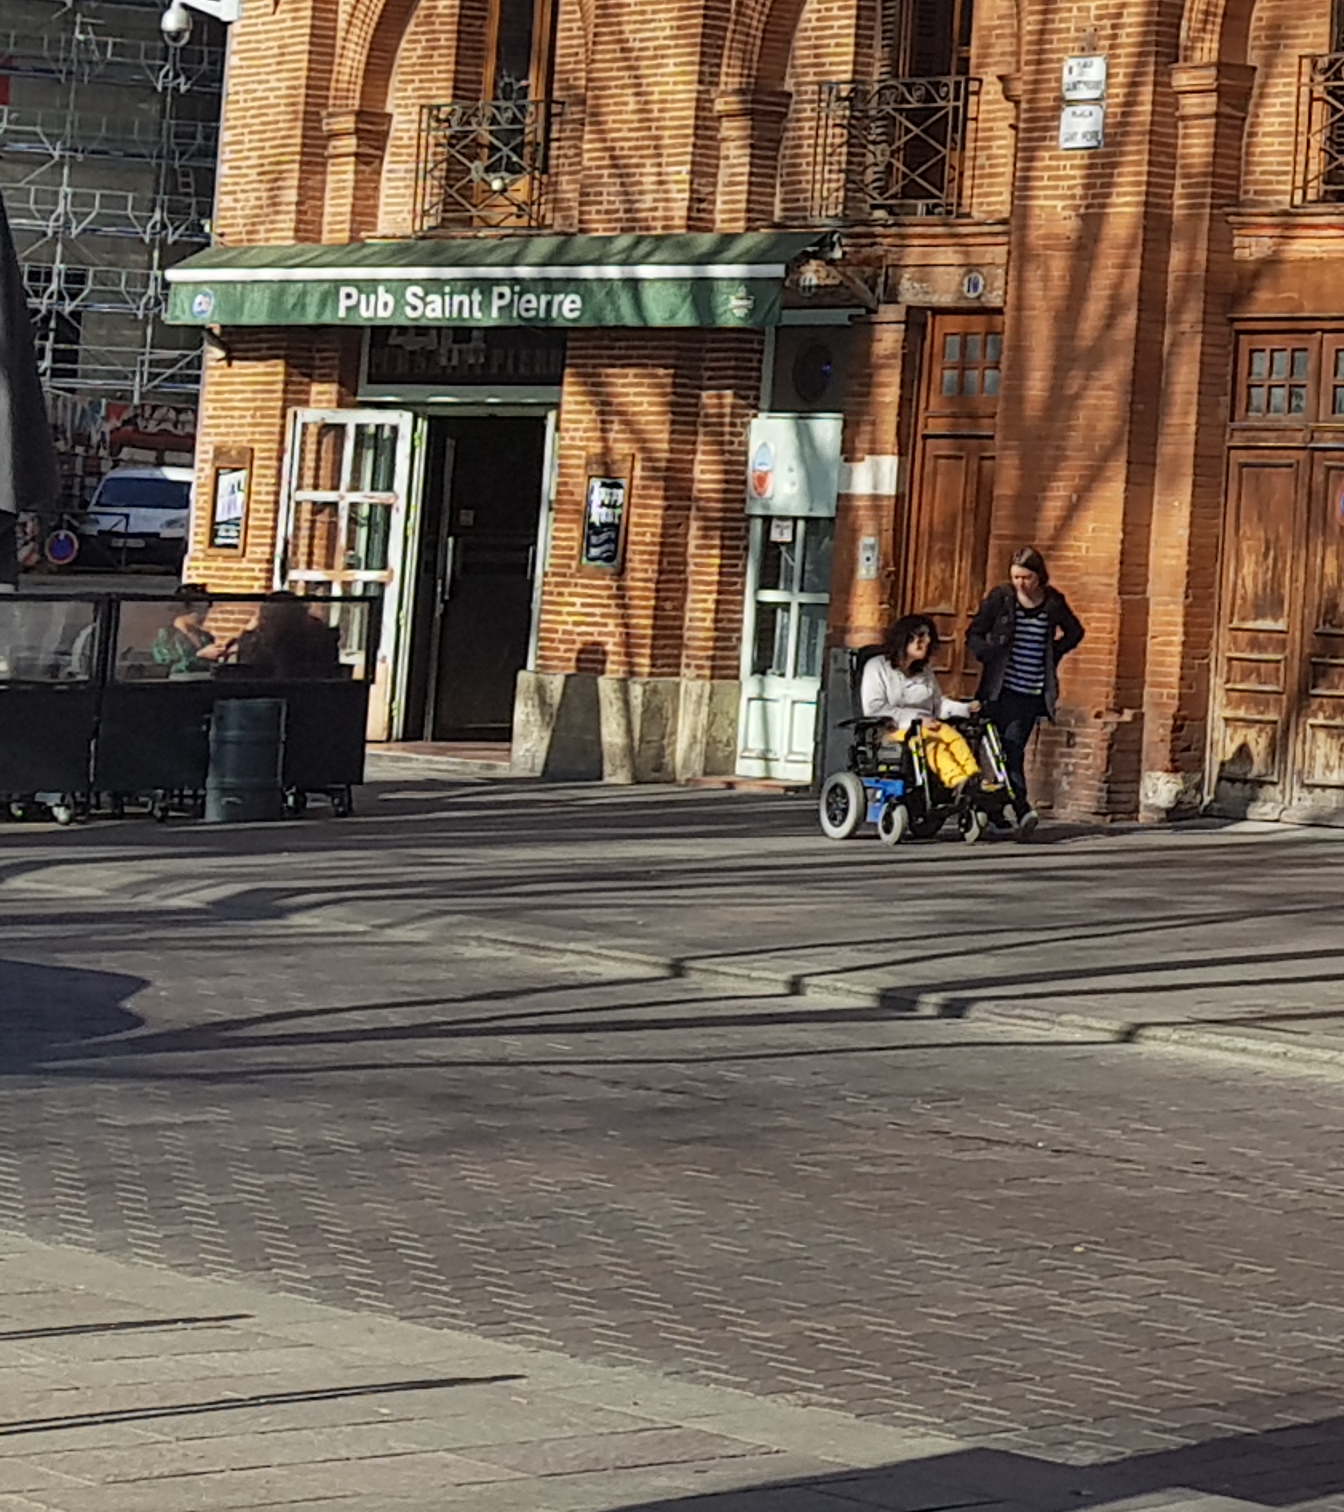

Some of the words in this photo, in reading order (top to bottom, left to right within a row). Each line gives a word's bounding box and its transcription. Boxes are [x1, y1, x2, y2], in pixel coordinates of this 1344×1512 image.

[338, 285, 395, 318] Pub
[404, 286, 482, 319] Saint
[491, 286, 583, 320] Pierre
